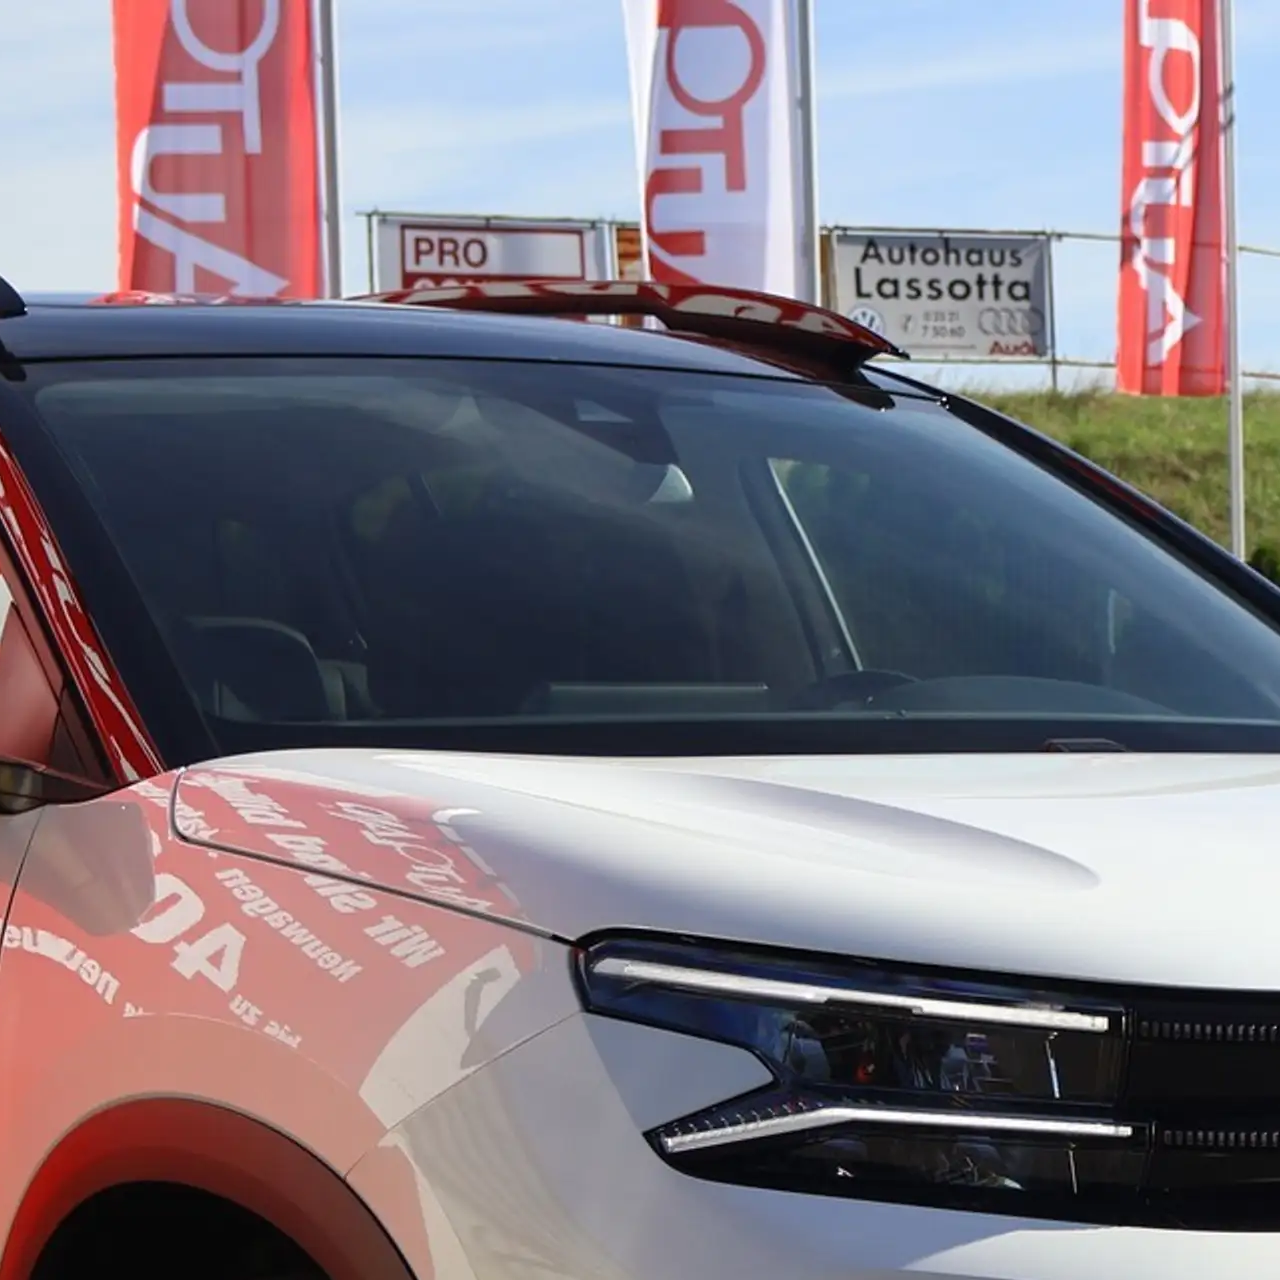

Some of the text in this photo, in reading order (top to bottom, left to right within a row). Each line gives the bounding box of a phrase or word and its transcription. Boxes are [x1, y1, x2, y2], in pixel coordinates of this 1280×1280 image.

[413, 237, 488, 268] PRO
[860, 237, 1023, 268] Autohaus
[854, 267, 1031, 302] Lassotta
